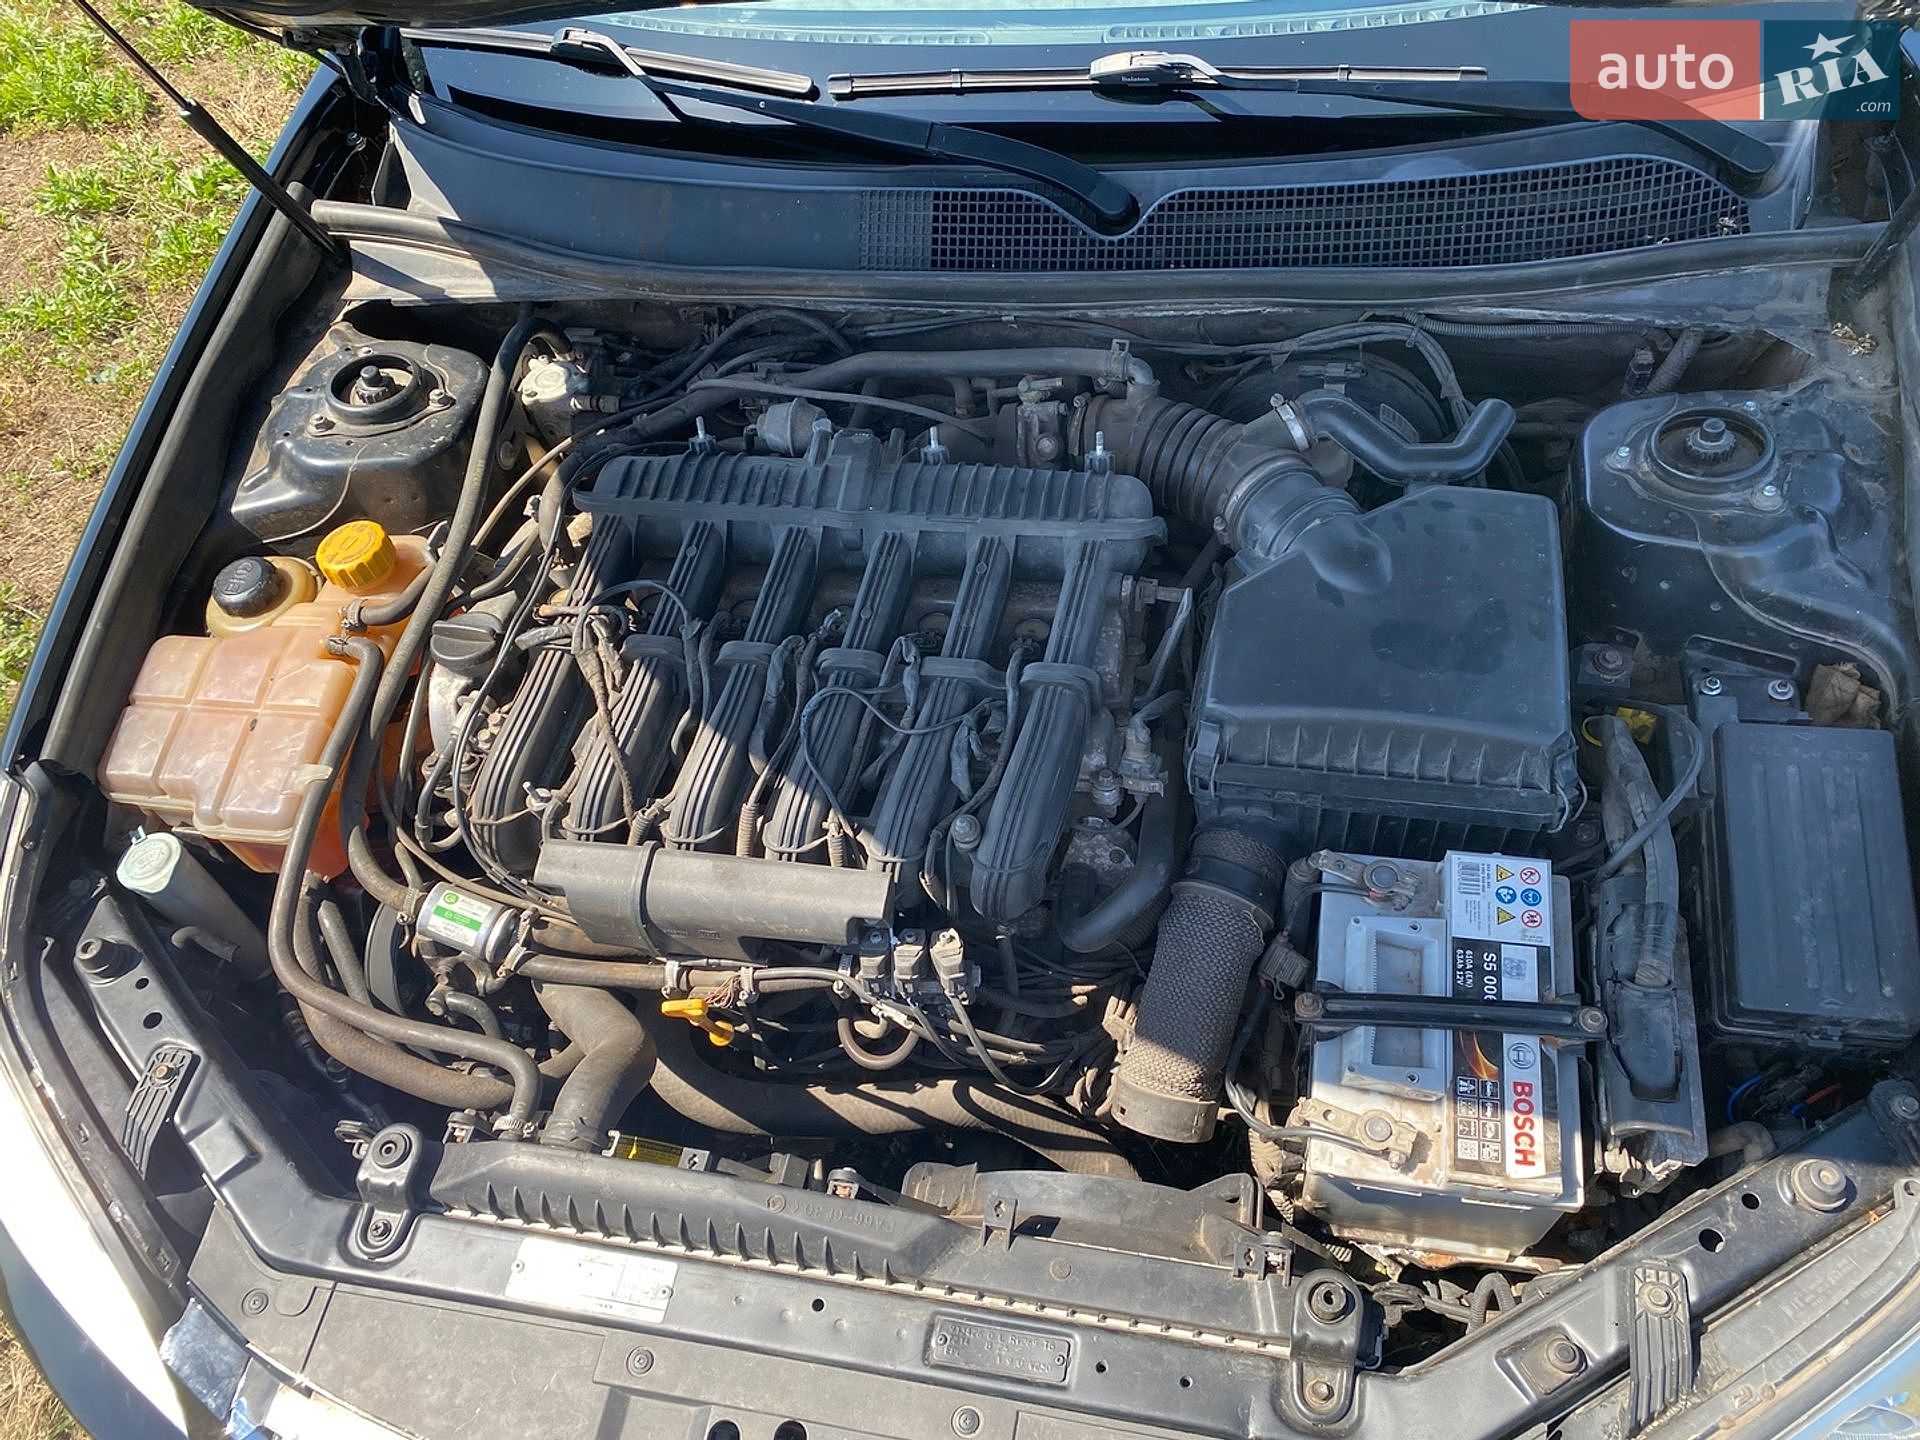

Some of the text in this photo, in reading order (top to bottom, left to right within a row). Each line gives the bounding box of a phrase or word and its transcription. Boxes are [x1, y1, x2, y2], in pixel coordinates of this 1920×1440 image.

[1456, 949, 1464, 985] 63Ah 12V
[1465, 949, 1473, 969] 610A
[1483, 952, 1497, 971] S5
[1512, 1080, 1536, 1168] BOSCH
